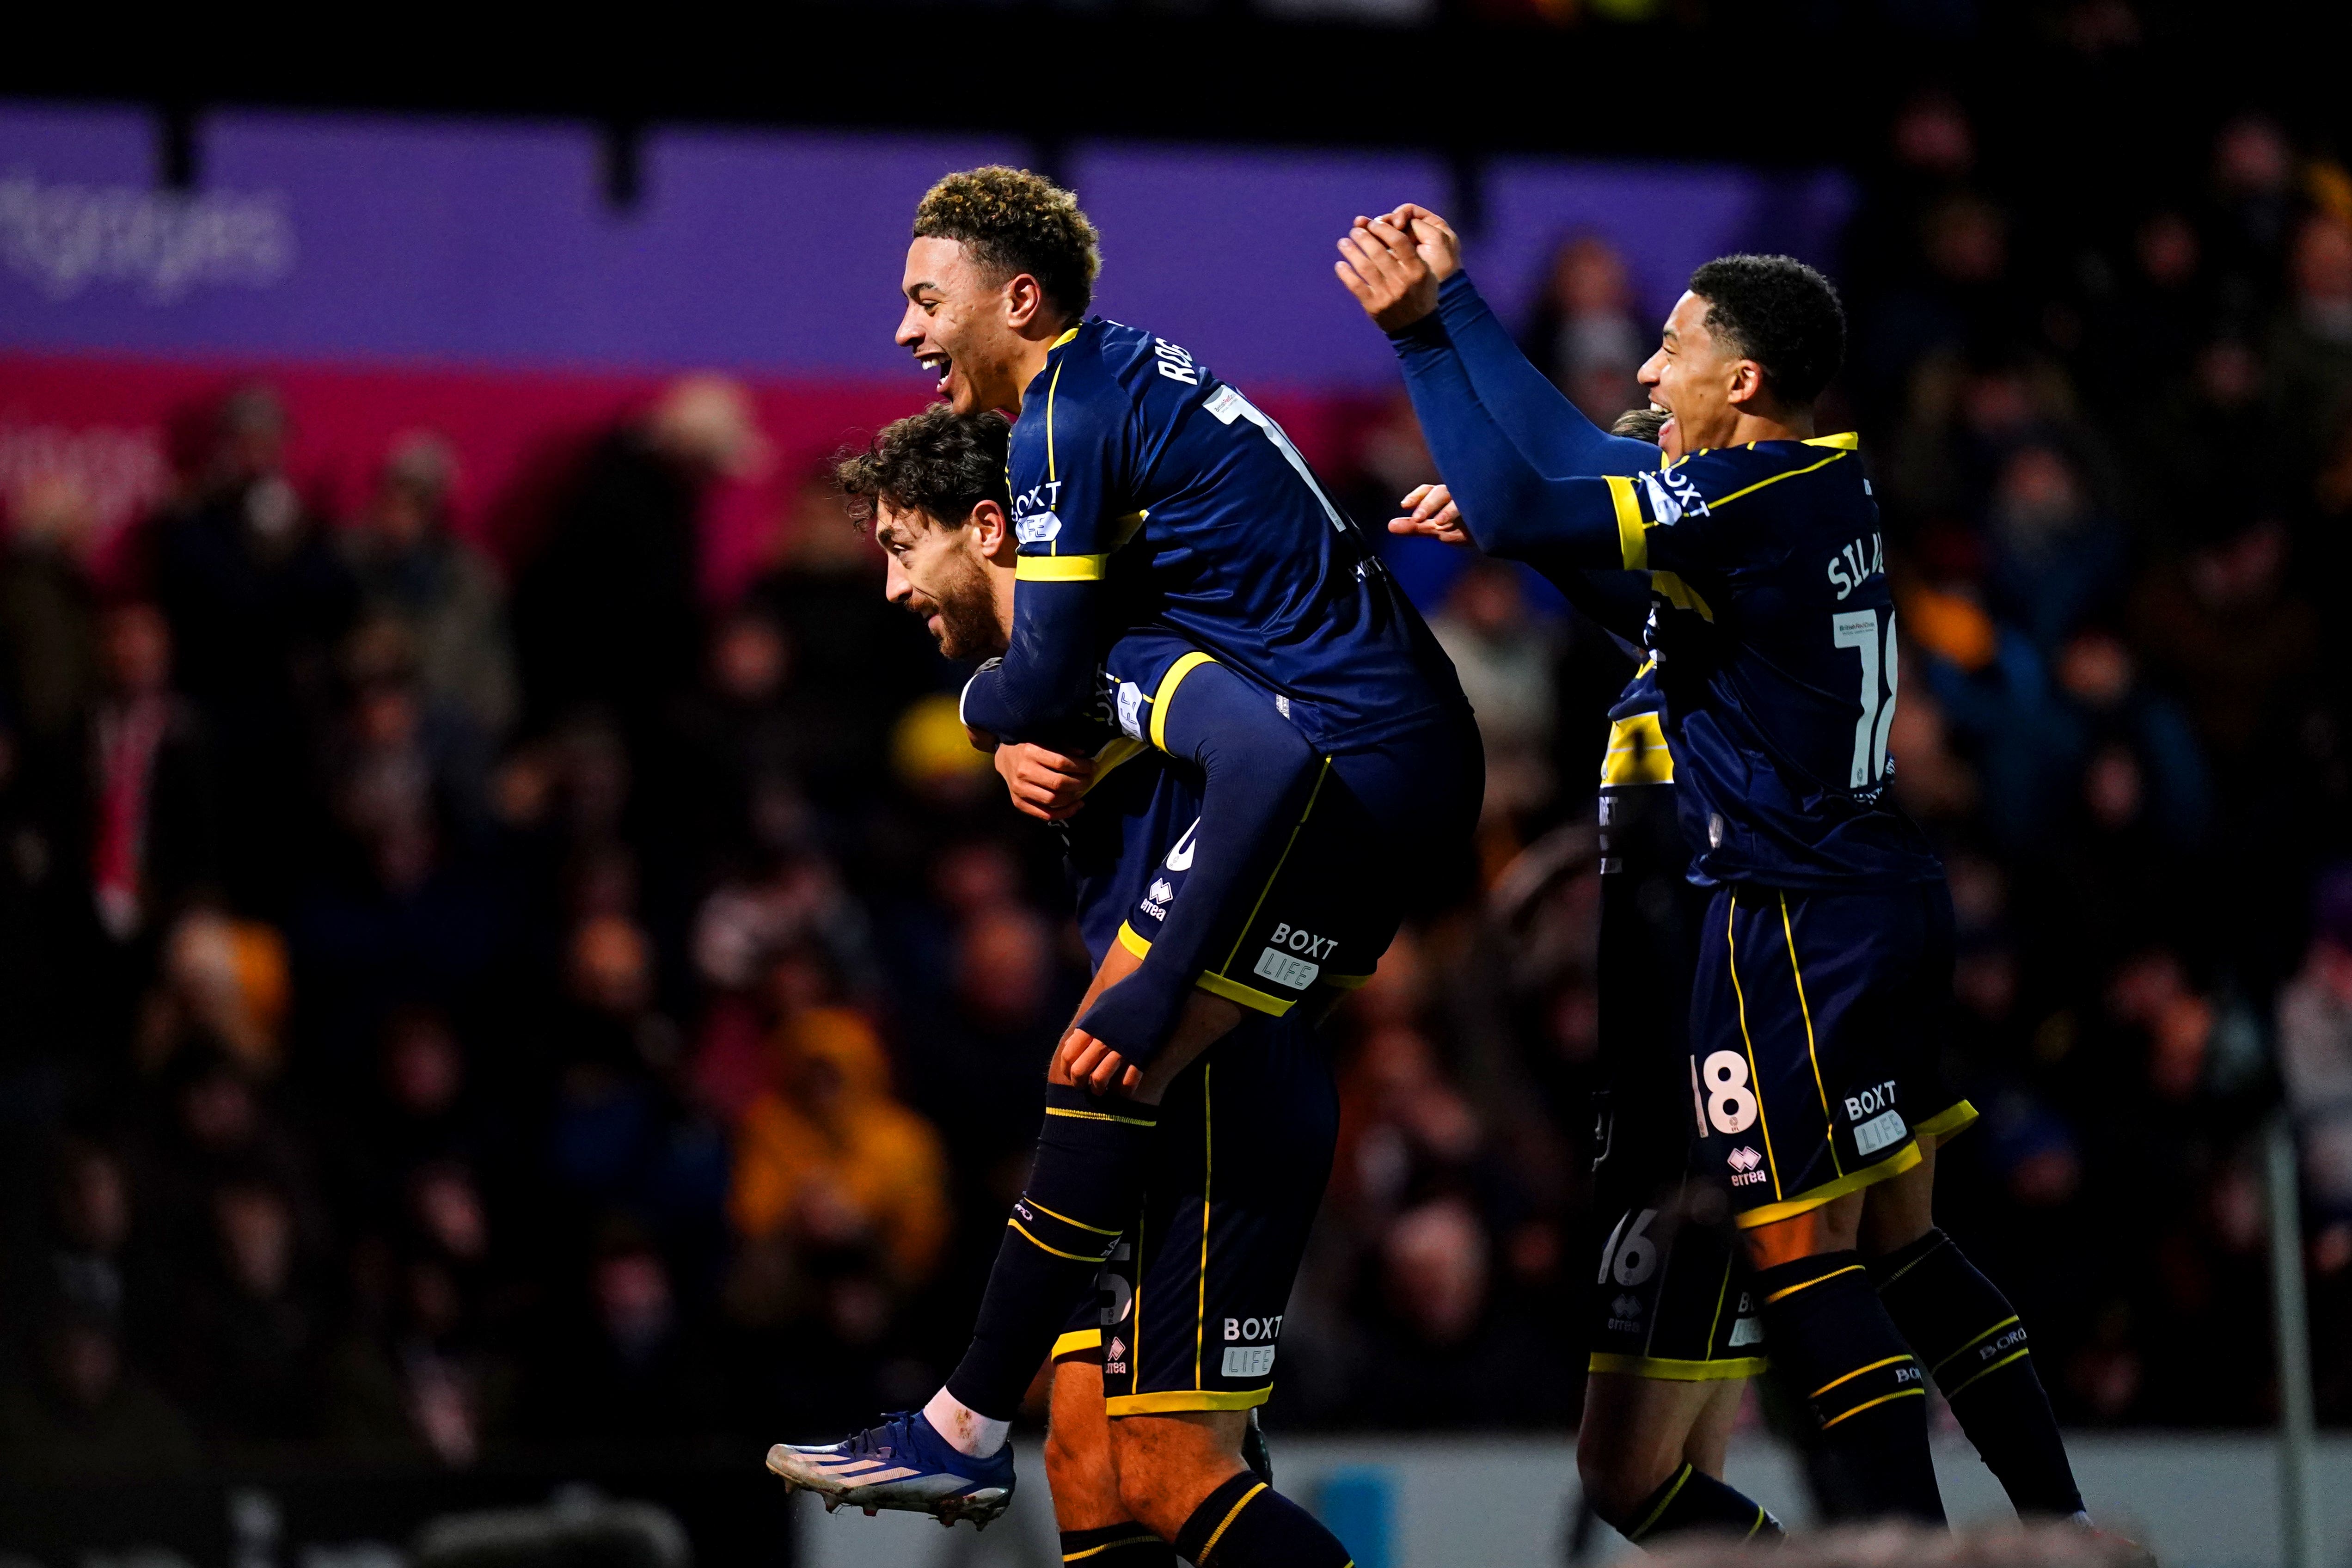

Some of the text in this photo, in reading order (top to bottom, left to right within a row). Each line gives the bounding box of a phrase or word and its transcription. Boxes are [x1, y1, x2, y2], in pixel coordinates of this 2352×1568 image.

[1660, 468, 1710, 517] OXT
[1140, 899, 1166, 922] errea
[1271, 923, 1339, 960] BOXT
[1262, 953, 1312, 986] LIFE
[1690, 1050, 1758, 1138] 18
[1844, 1080, 1896, 1121] BOXT
[1862, 1114, 1904, 1150] LIFE
[1731, 1170, 1767, 1187] errea
[1598, 1207, 1659, 1286] 16
[1224, 1315, 1283, 1340] BOXT
[1229, 1349, 1271, 1372] LIFE
